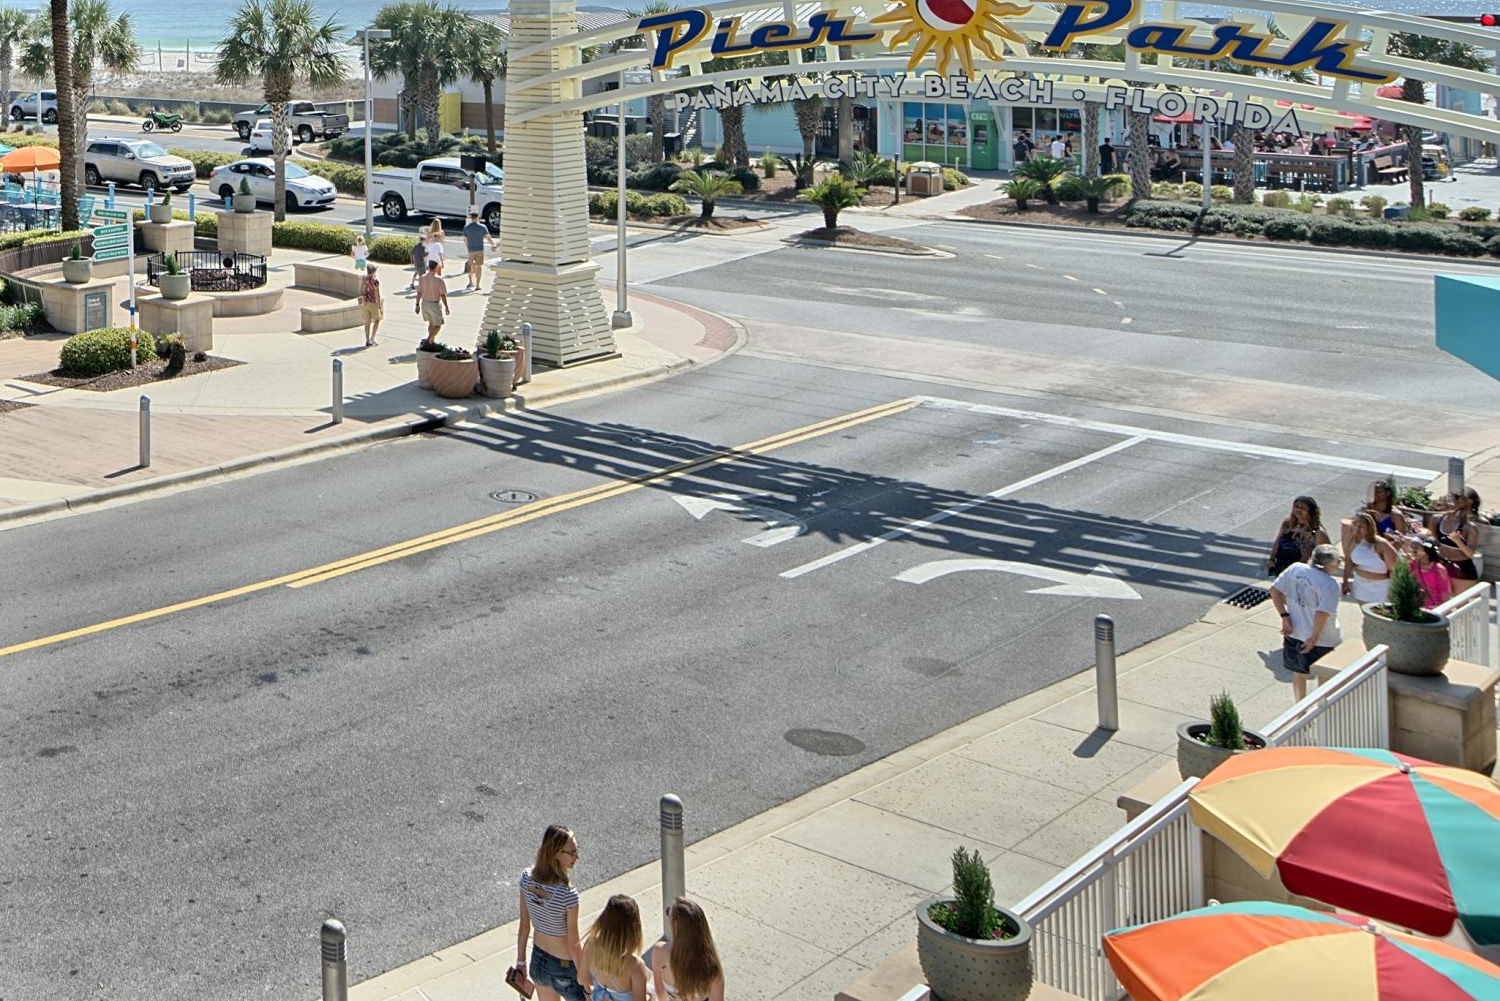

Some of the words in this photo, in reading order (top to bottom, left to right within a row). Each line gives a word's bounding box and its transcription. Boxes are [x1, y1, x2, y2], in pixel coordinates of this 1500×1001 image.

[637, 6, 883, 72] Pier
[674, 77, 808, 113] PANAMA
[823, 75, 907, 100] CITY
[924, 74, 1054, 105] BEACH
[1105, 85, 1303, 138] FLORIDA
